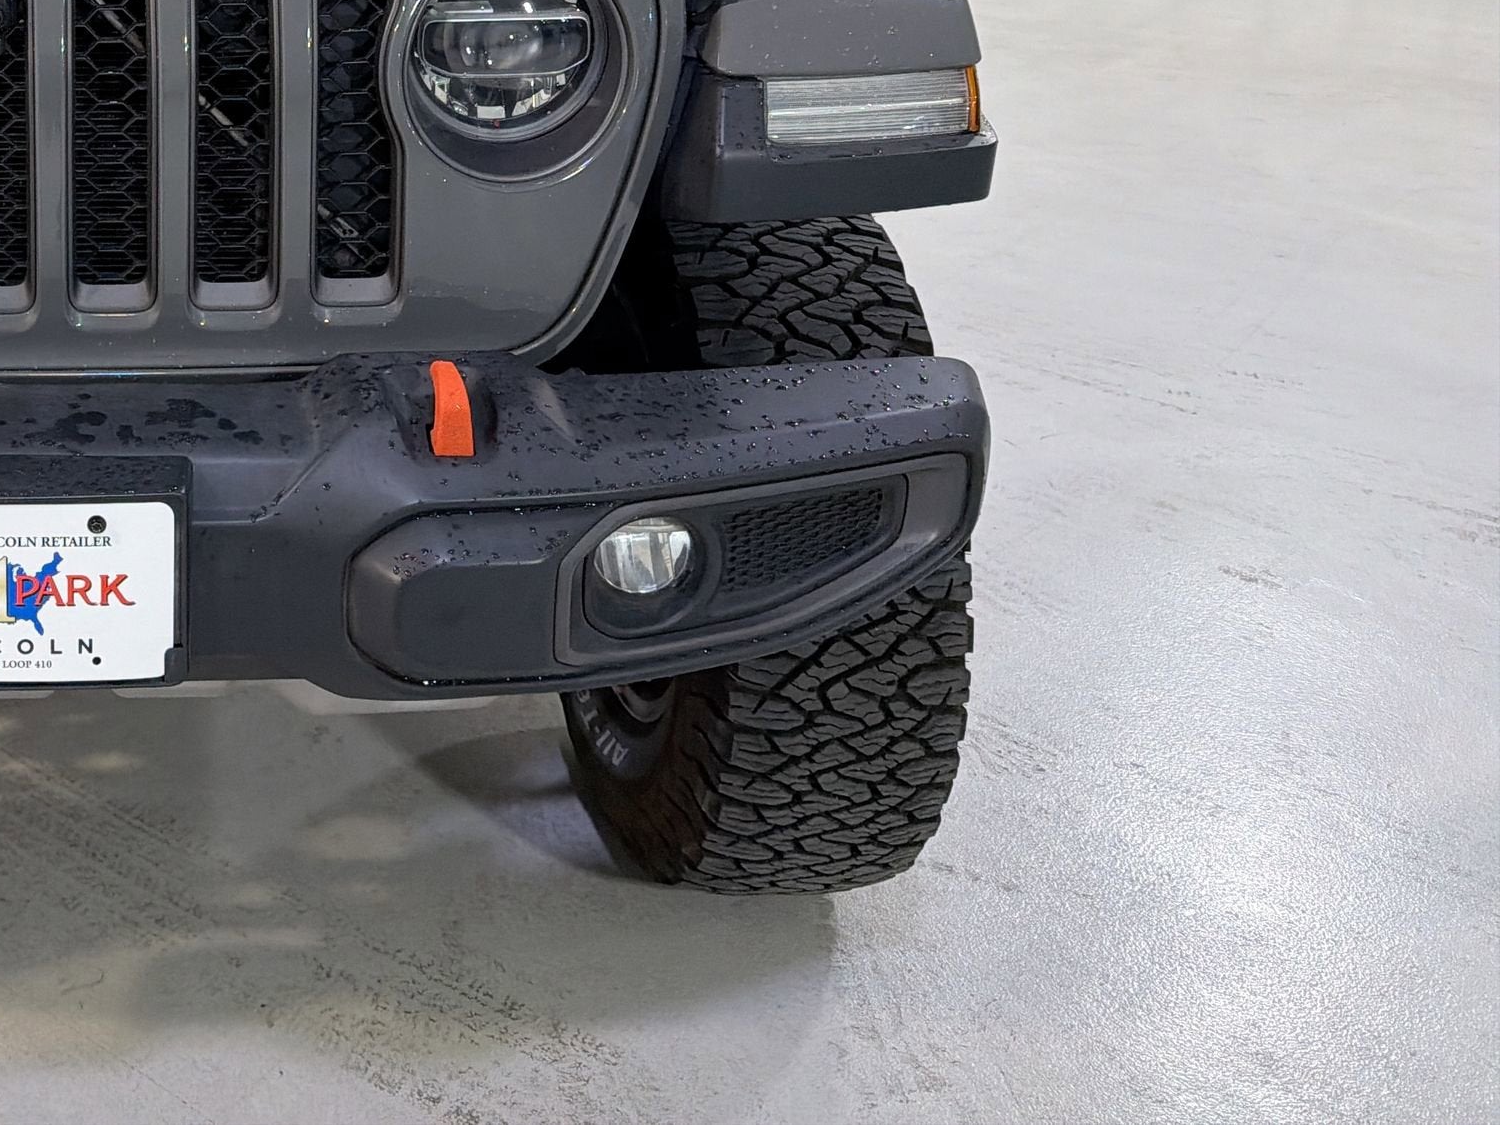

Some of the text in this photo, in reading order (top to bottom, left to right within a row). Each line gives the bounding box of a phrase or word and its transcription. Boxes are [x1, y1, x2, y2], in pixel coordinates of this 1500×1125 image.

[41, 535, 113, 548] RETAILER
[14, 573, 137, 607] PARK
[2, 660, 32, 669] LOOP
[34, 660, 53, 669] 410
